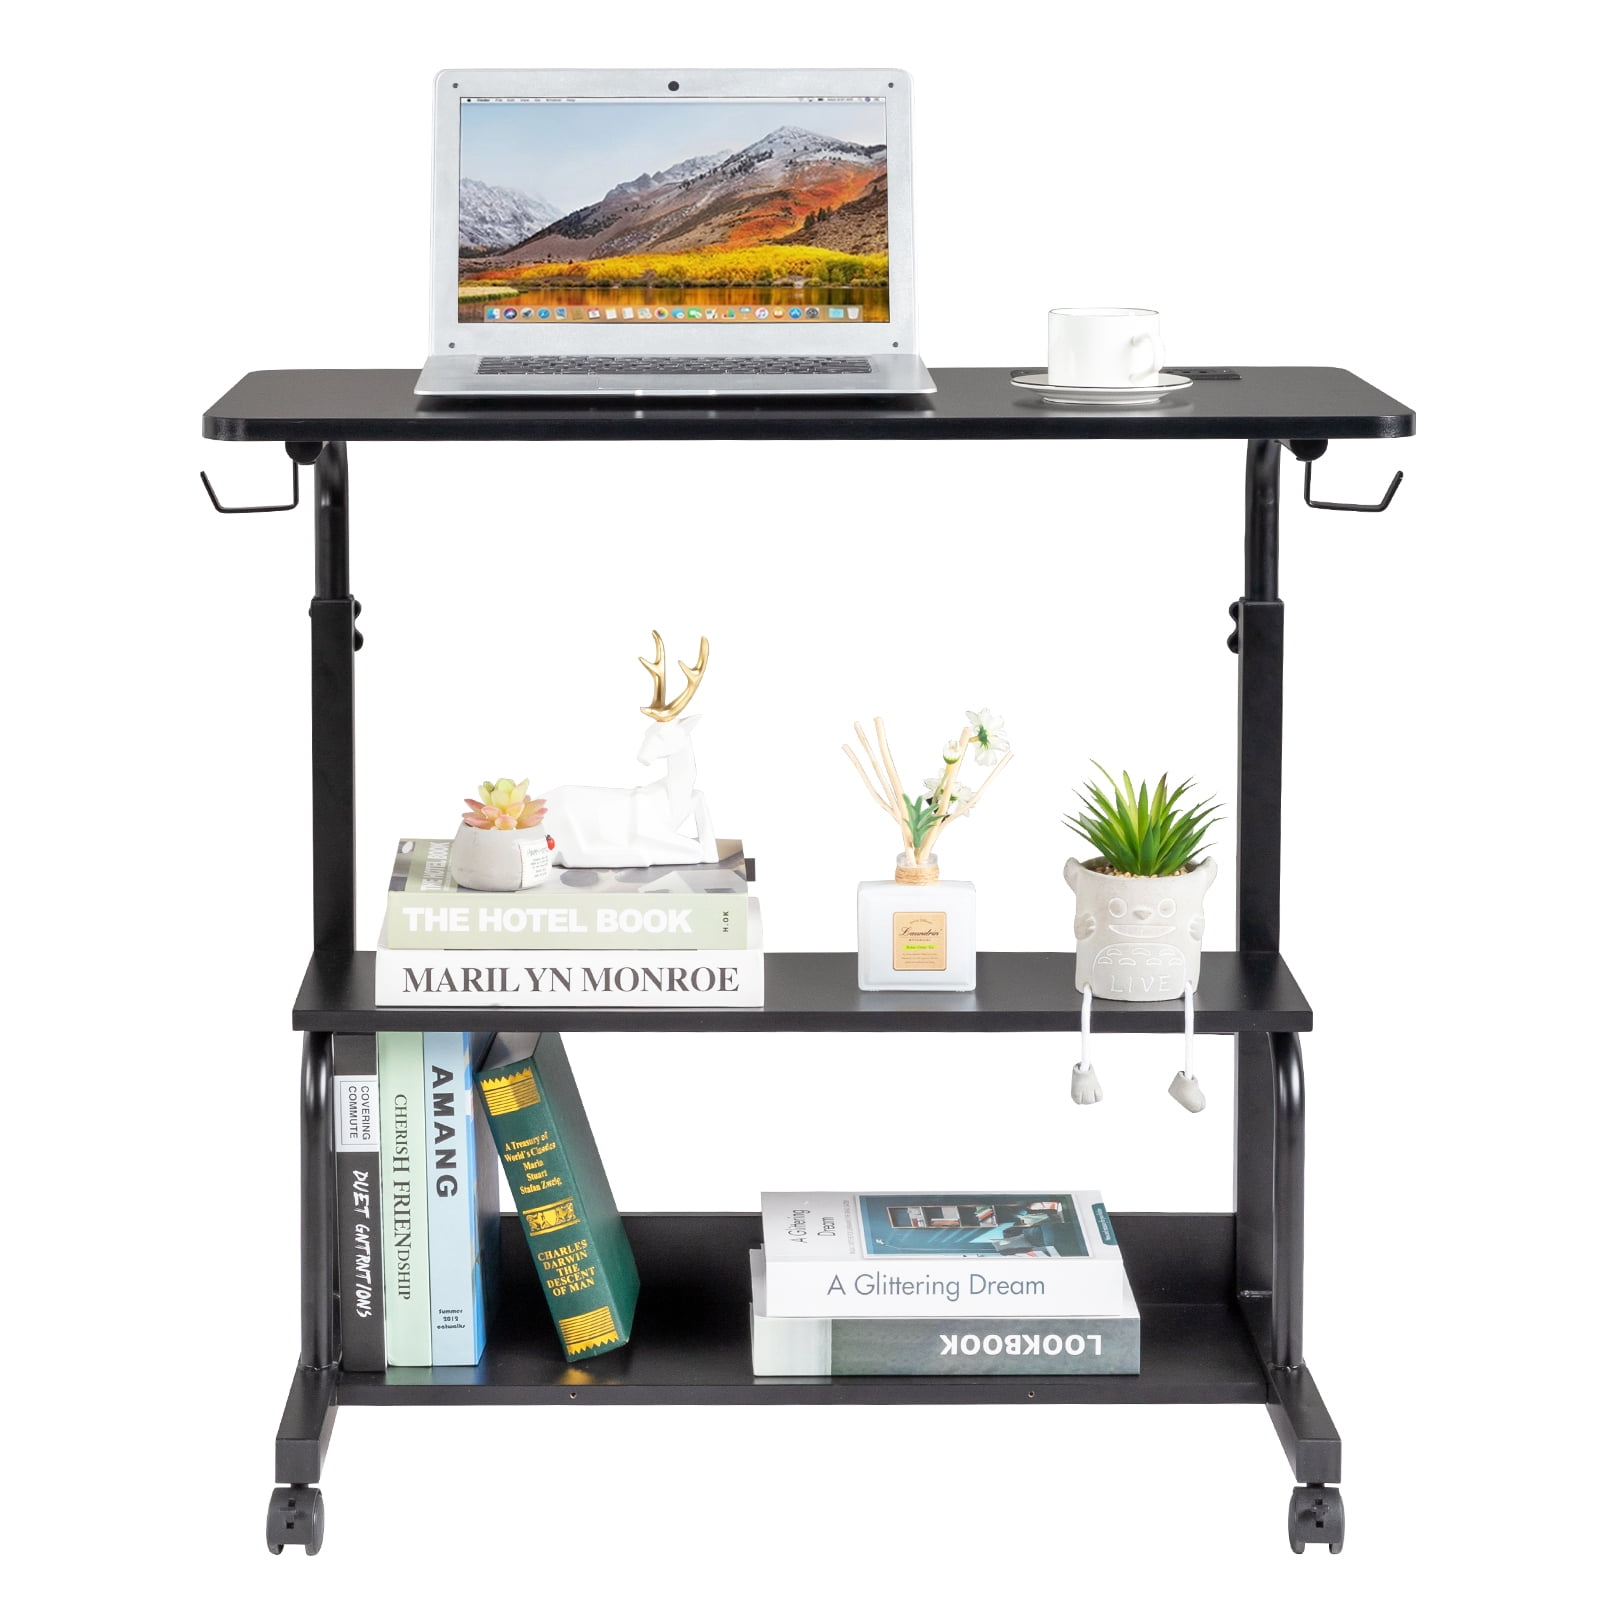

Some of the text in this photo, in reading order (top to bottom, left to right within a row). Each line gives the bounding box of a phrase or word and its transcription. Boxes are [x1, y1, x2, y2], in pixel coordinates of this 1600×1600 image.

[403, 908, 693, 933] THE HOTEL BOOK
[581, 967, 739, 993] MONROE
[1110, 975, 1172, 993] LIVE
[348, 1085, 358, 1139] COMMUTE
[361, 1085, 371, 1141] COVERING
[431, 1064, 459, 1199] AMANG
[505, 1131, 549, 1151] A Treasury of
[504, 1150, 531, 1162] World's
[526, 1169, 548, 1182] Stuart
[352, 1170, 370, 1220] DUET
[393, 1094, 412, 1301] CHERISH FRIENDSHIP
[817, 1216, 836, 1237] Dream
[537, 1239, 588, 1262] CHARLES
[543, 1250, 588, 1270] DARWIN
[546, 1266, 596, 1289] DESCENT
[556, 1263, 580, 1277] THE
[552, 1277, 595, 1297] OF MAN
[827, 1271, 1045, 1302] A Glittering Dream
[939, 1334, 1102, 1356] LOOKBOOK
